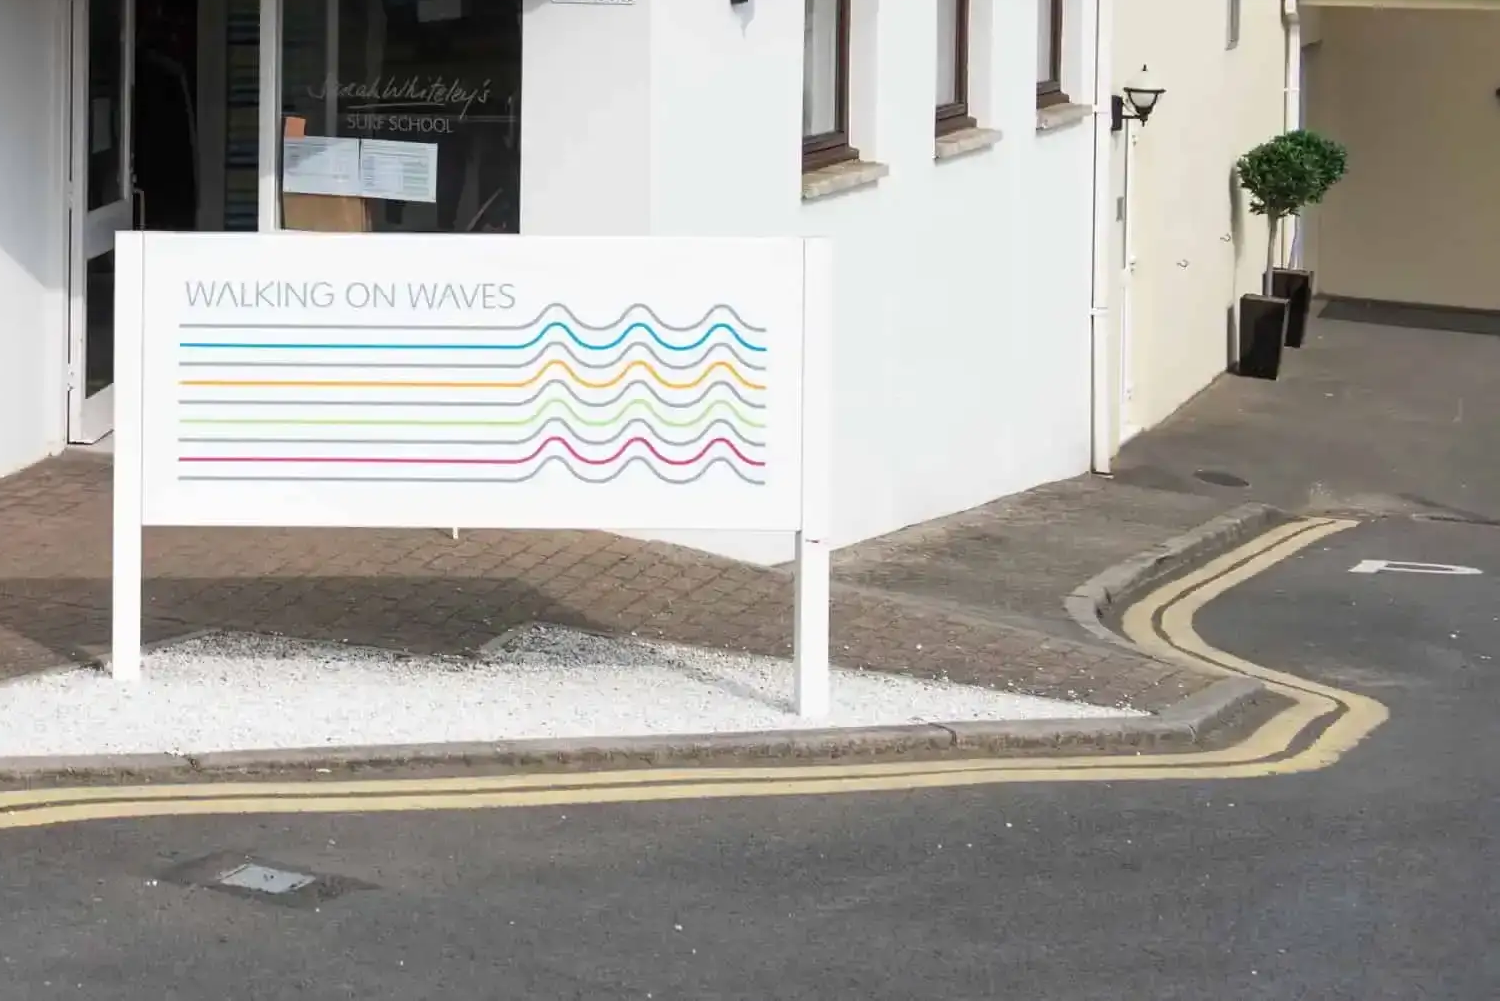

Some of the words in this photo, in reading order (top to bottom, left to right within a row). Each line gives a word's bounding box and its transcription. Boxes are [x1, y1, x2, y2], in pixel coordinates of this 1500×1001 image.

[347, 115, 385, 130] SURF
[388, 116, 454, 133] SCHOOL
[185, 281, 335, 308] WALKING
[346, 282, 395, 308] ON
[408, 283, 516, 309] WAVES
